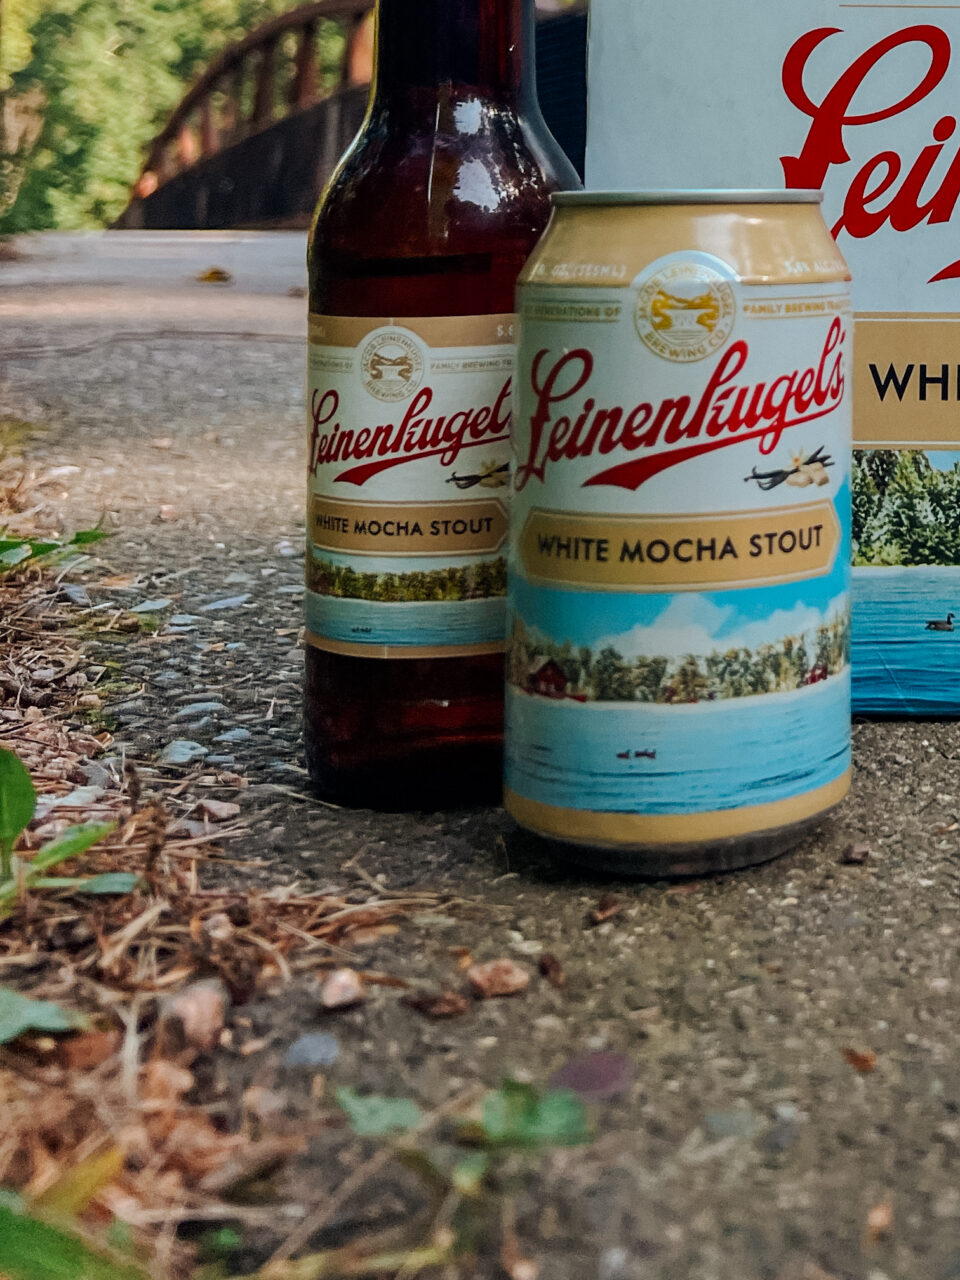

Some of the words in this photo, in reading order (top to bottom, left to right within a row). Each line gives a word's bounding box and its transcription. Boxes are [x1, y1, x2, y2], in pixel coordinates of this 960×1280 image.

[308, 374, 512, 487] Leinenkugel
[515, 315, 846, 491] Leinenkugel's
[315, 513, 349, 534] WHITE
[354, 519, 424, 537] MOCHA
[430, 517, 494, 536] STOUT
[537, 533, 609, 562] WHITE
[619, 537, 739, 564] MOCHA
[749, 524, 824, 558] STOUT
